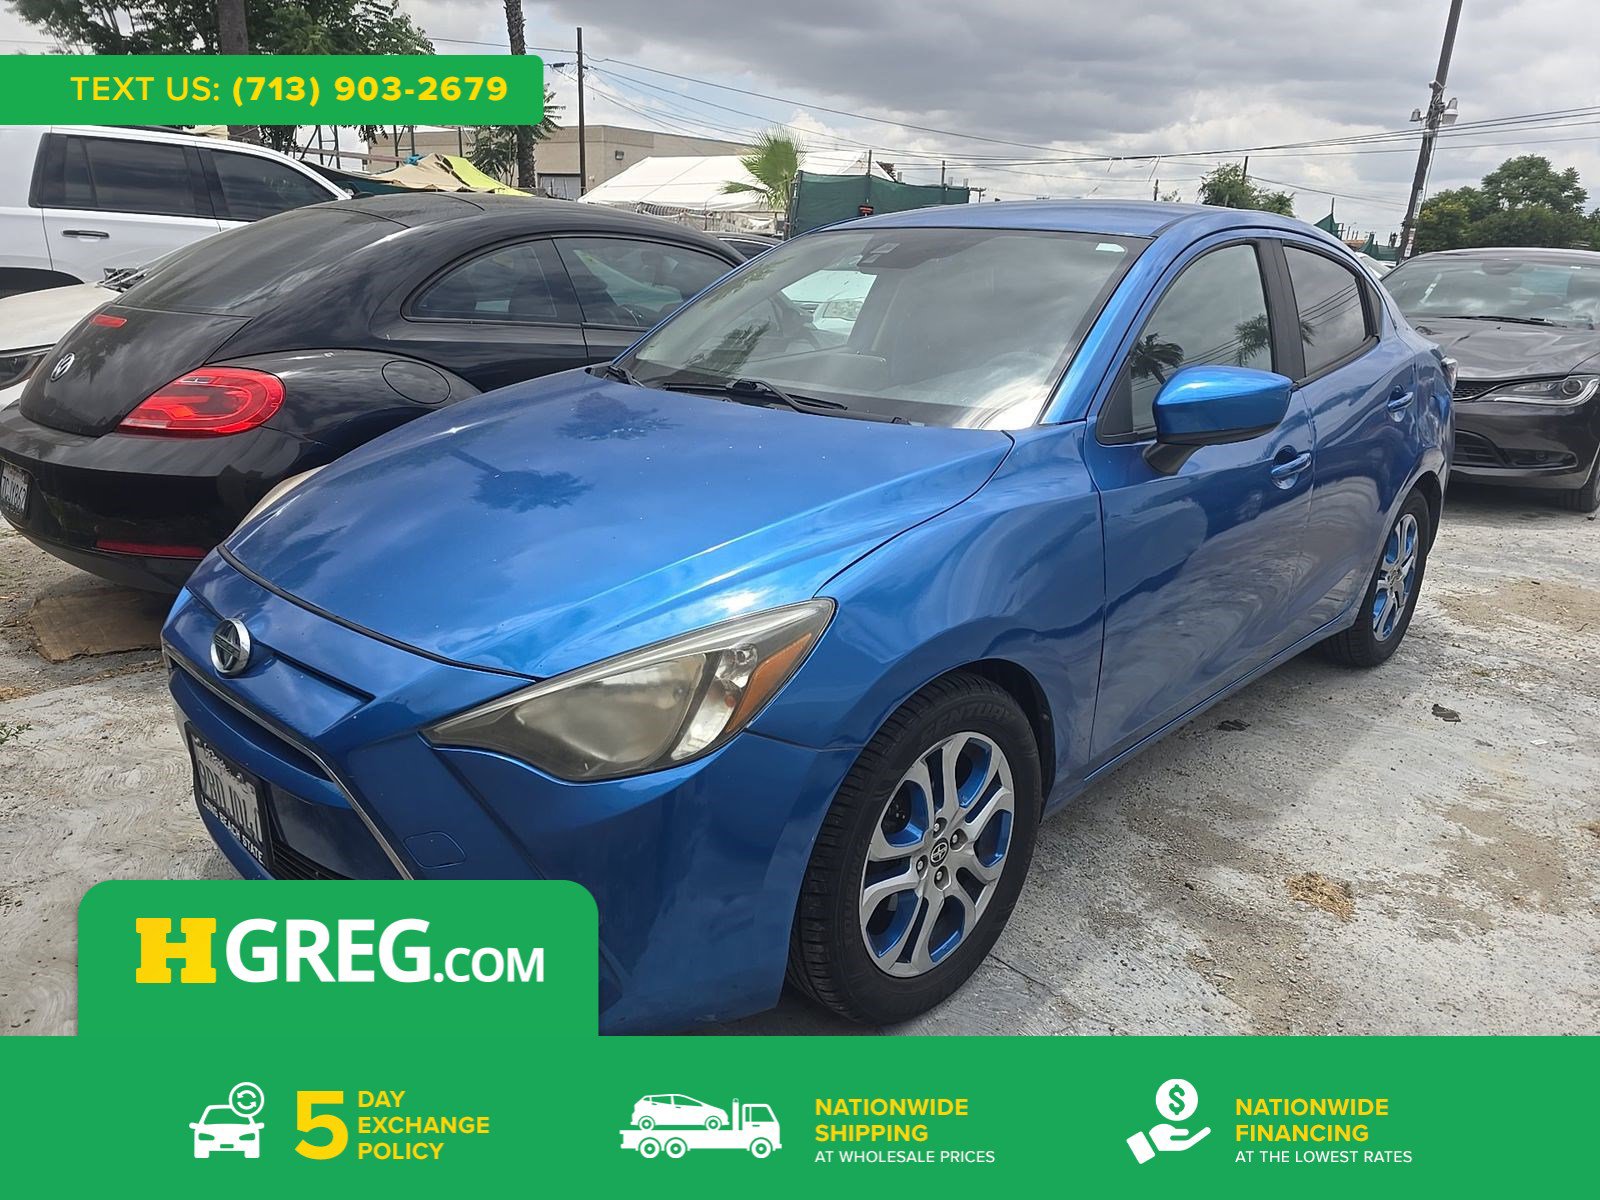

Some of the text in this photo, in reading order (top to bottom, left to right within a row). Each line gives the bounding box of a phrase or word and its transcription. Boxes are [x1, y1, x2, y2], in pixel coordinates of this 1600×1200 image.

[201, 794, 266, 867] LONG BEACH STATE
